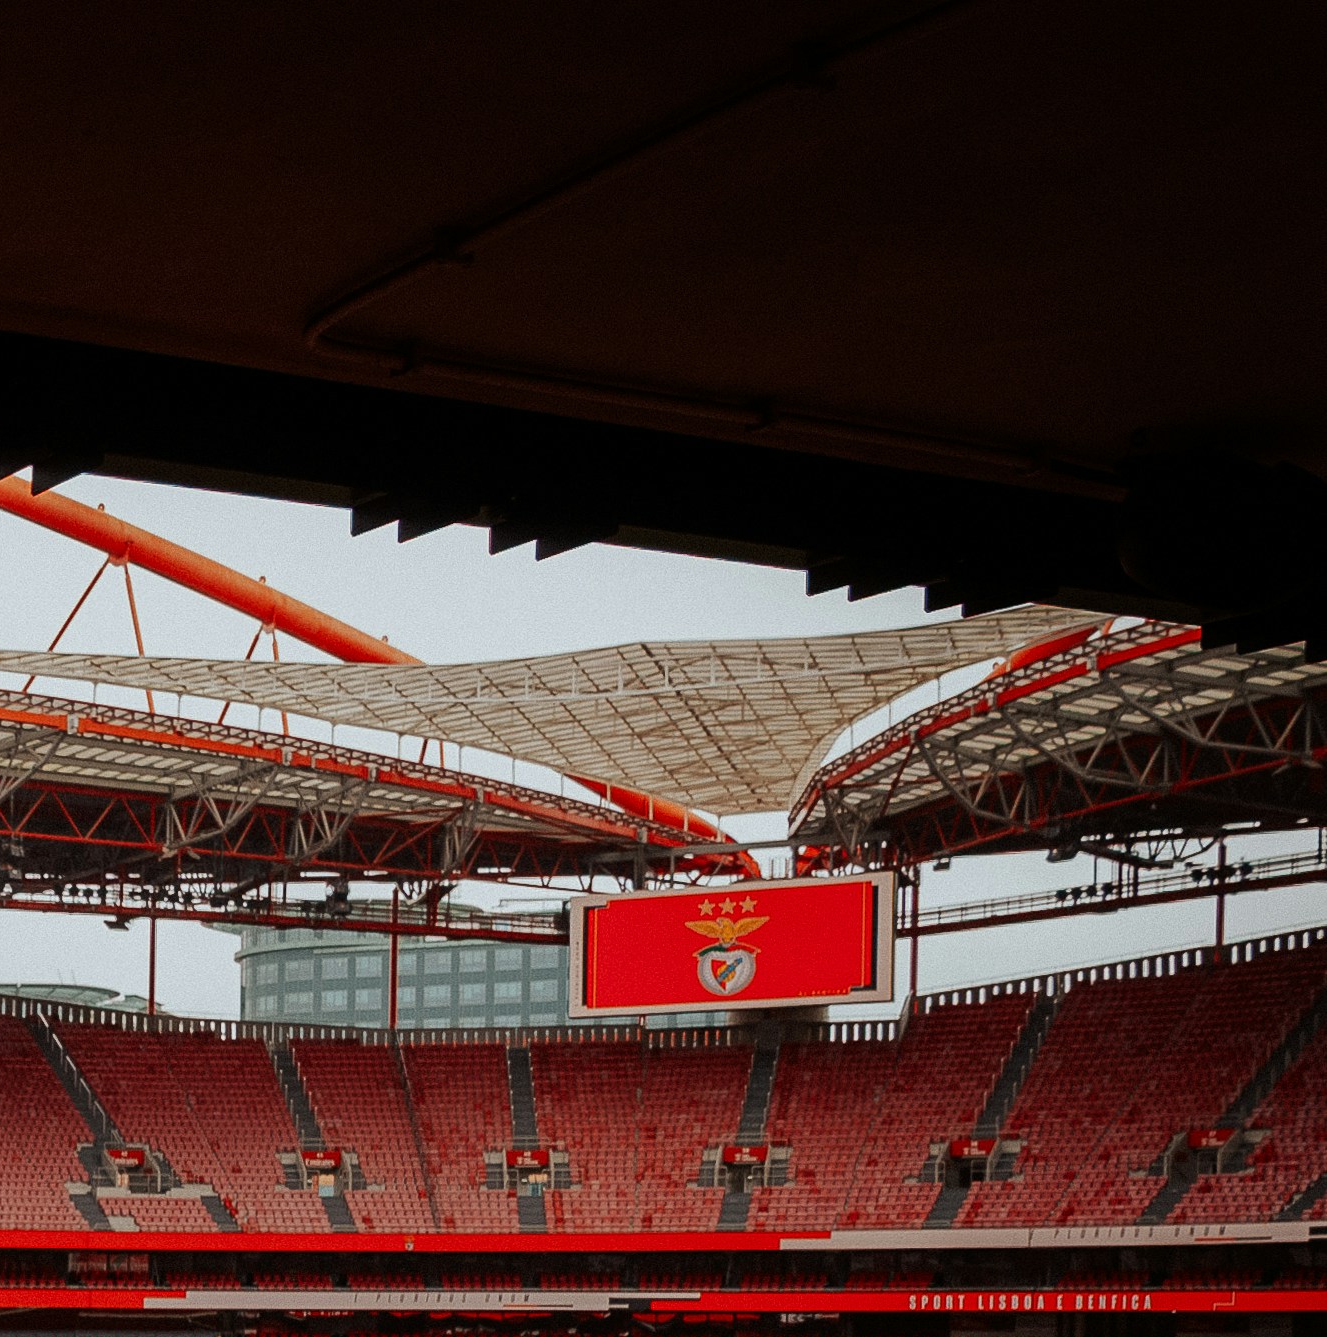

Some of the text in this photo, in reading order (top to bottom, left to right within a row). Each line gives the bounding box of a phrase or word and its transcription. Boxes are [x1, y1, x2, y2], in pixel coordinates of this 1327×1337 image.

[908, 1294, 1152, 1311] SPORT LISBOA E BENFICA
